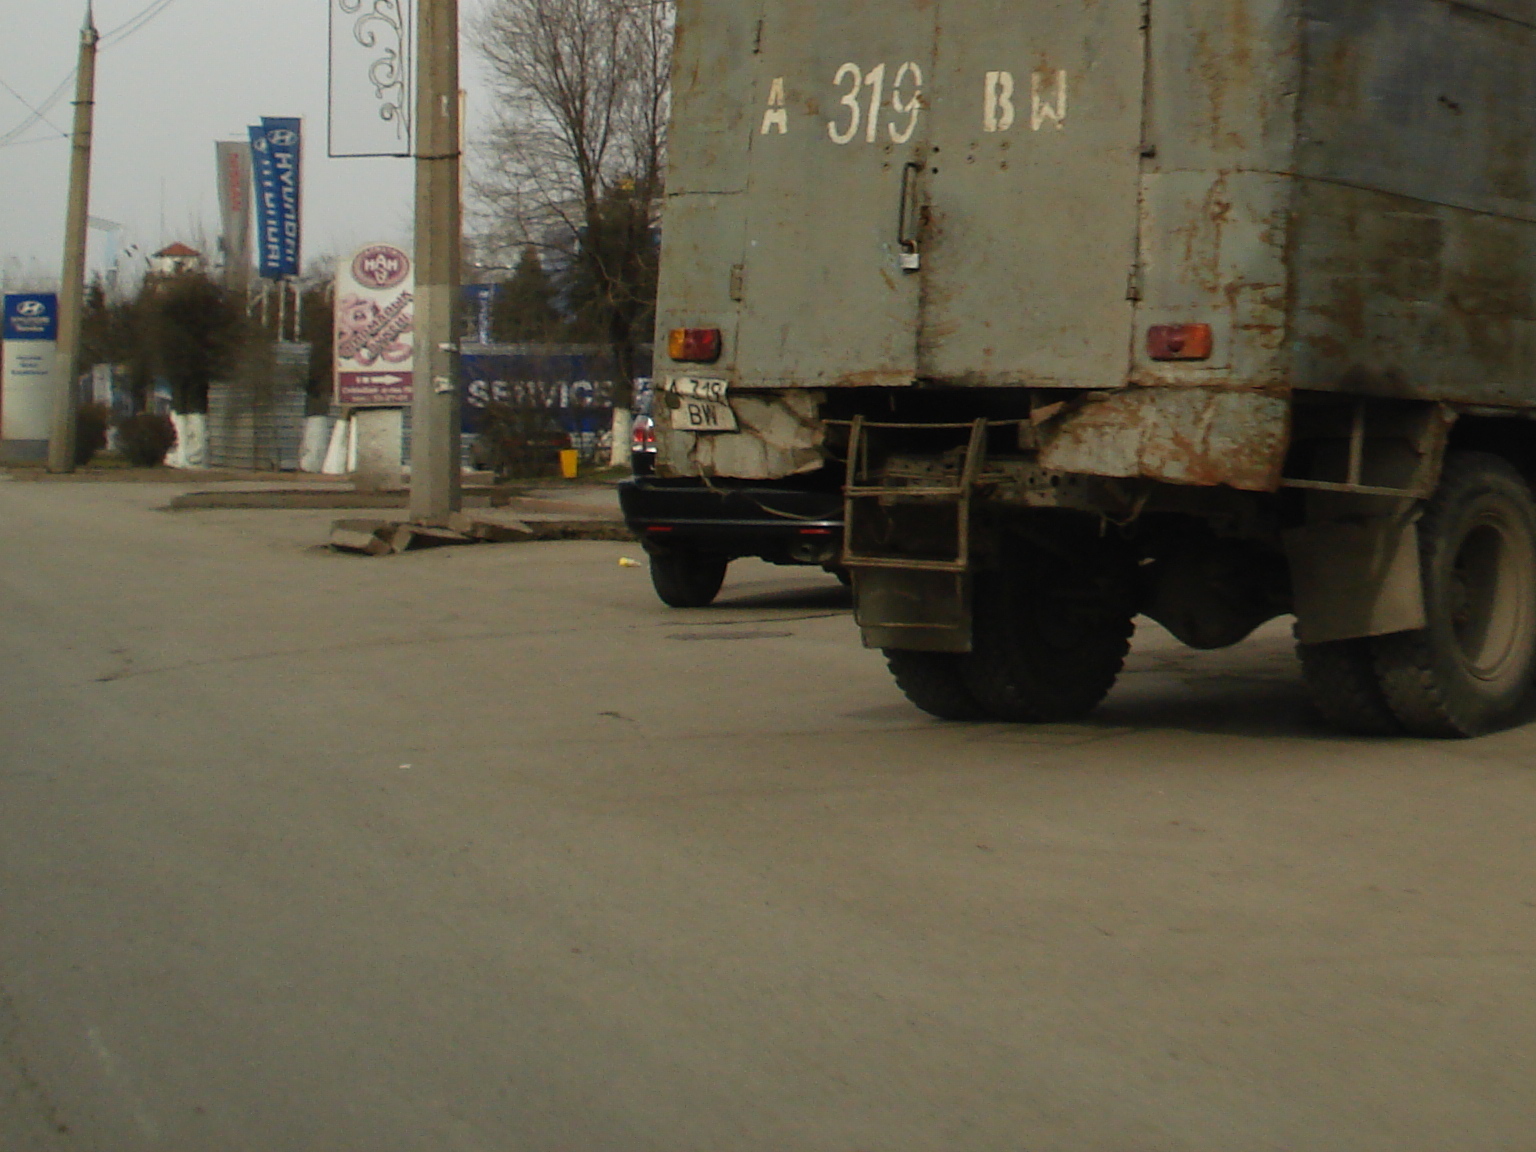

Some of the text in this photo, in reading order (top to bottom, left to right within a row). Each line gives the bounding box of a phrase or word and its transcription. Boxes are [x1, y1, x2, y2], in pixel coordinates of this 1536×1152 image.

[761, 77, 788, 135] A
[828, 61, 923, 145] 319
[688, 403, 718, 426] BW
